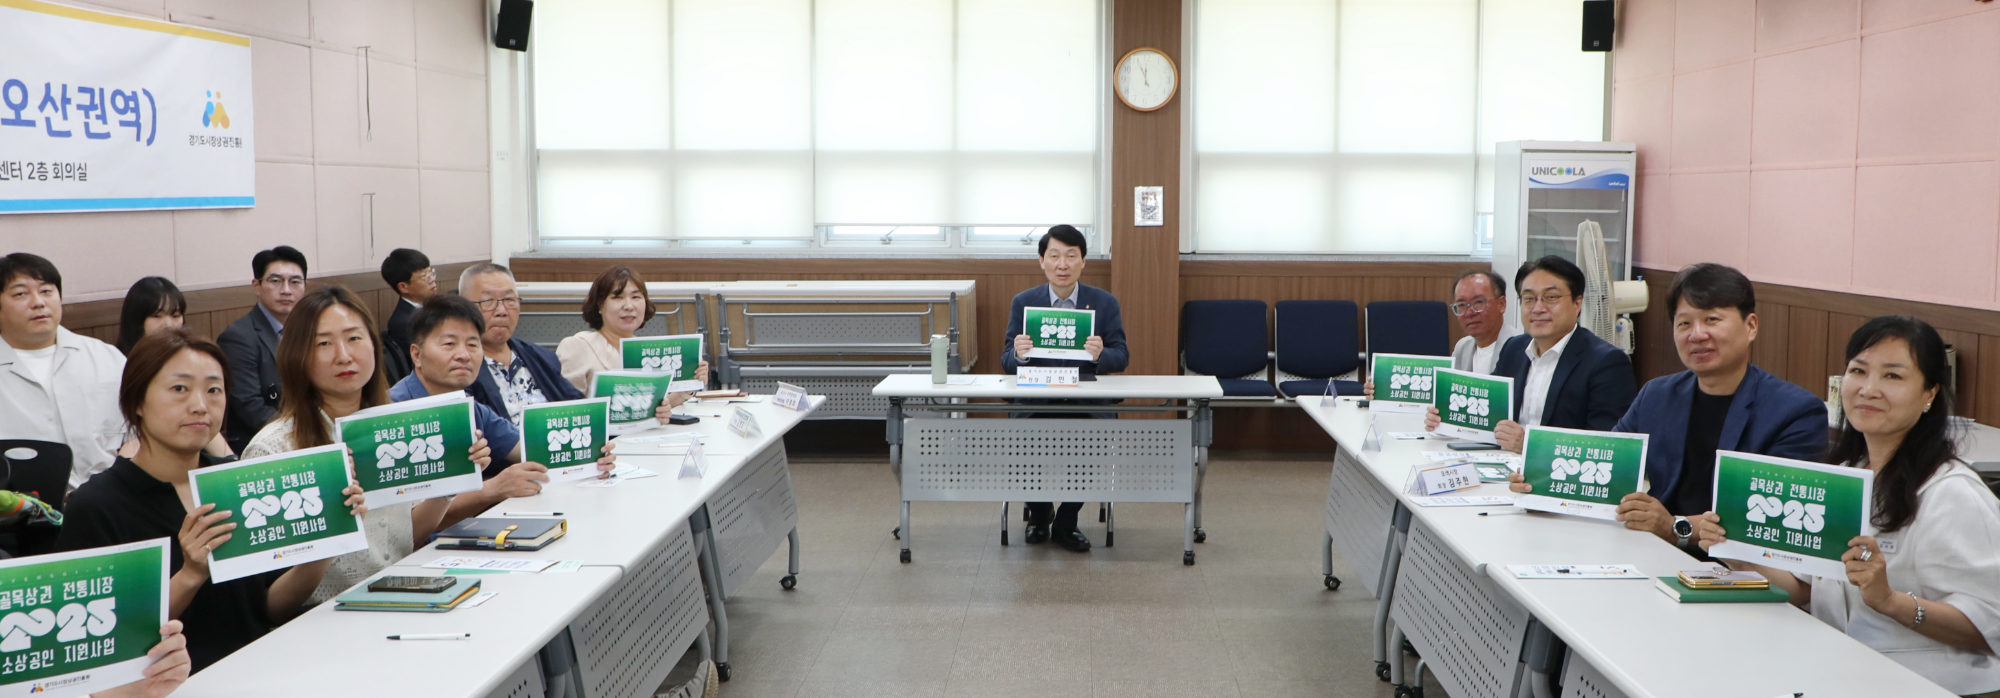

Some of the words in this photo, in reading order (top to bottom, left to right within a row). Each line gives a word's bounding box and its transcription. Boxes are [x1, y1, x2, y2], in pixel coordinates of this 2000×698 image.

[1, 79, 156, 146] 오산권역)
[0, 160, 22, 180] 센터
[26, 161, 48, 181] 2층
[52, 162, 87, 181] 회의실
[1532, 167, 1586, 176] UNICOOLA
[1040, 324, 1076, 339] 2025
[641, 354, 682, 371] 2025
[1390, 373, 1432, 391] 2025
[1449, 393, 1489, 416] 2025
[374, 426, 405, 442] 골목상권
[410, 421, 440, 437] 전통시장
[547, 426, 592, 451] 2025
[376, 434, 445, 469] 2025
[1554, 445, 1582, 458] 골목상권
[1586, 448, 1614, 460] 전통시장
[379, 467, 409, 483] 소상공인
[414, 460, 445, 476] 지원사업
[1550, 457, 1613, 485] 2025
[238, 478, 275, 498] 골목상권
[281, 470, 315, 490] 전통시장
[1549, 482, 1576, 494] 소상공인
[1580, 485, 1609, 498] 지원사업
[1750, 477, 1783, 495] 골목상권
[1789, 482, 1826, 501] 전통시장
[241, 486, 323, 528] 2025
[1746, 494, 1826, 533] 2025
[249, 525, 286, 545] 소상공인
[291, 517, 327, 536] 지원사업
[1746, 524, 1780, 542] 소상공인
[1786, 530, 1822, 550] 지원사업
[0, 585, 52, 610] 골목상권
[63, 576, 114, 600] 전통시장
[0, 596, 117, 652] 2025
[2, 649, 54, 675] 소상공인
[64, 637, 115, 664] 지원사업
